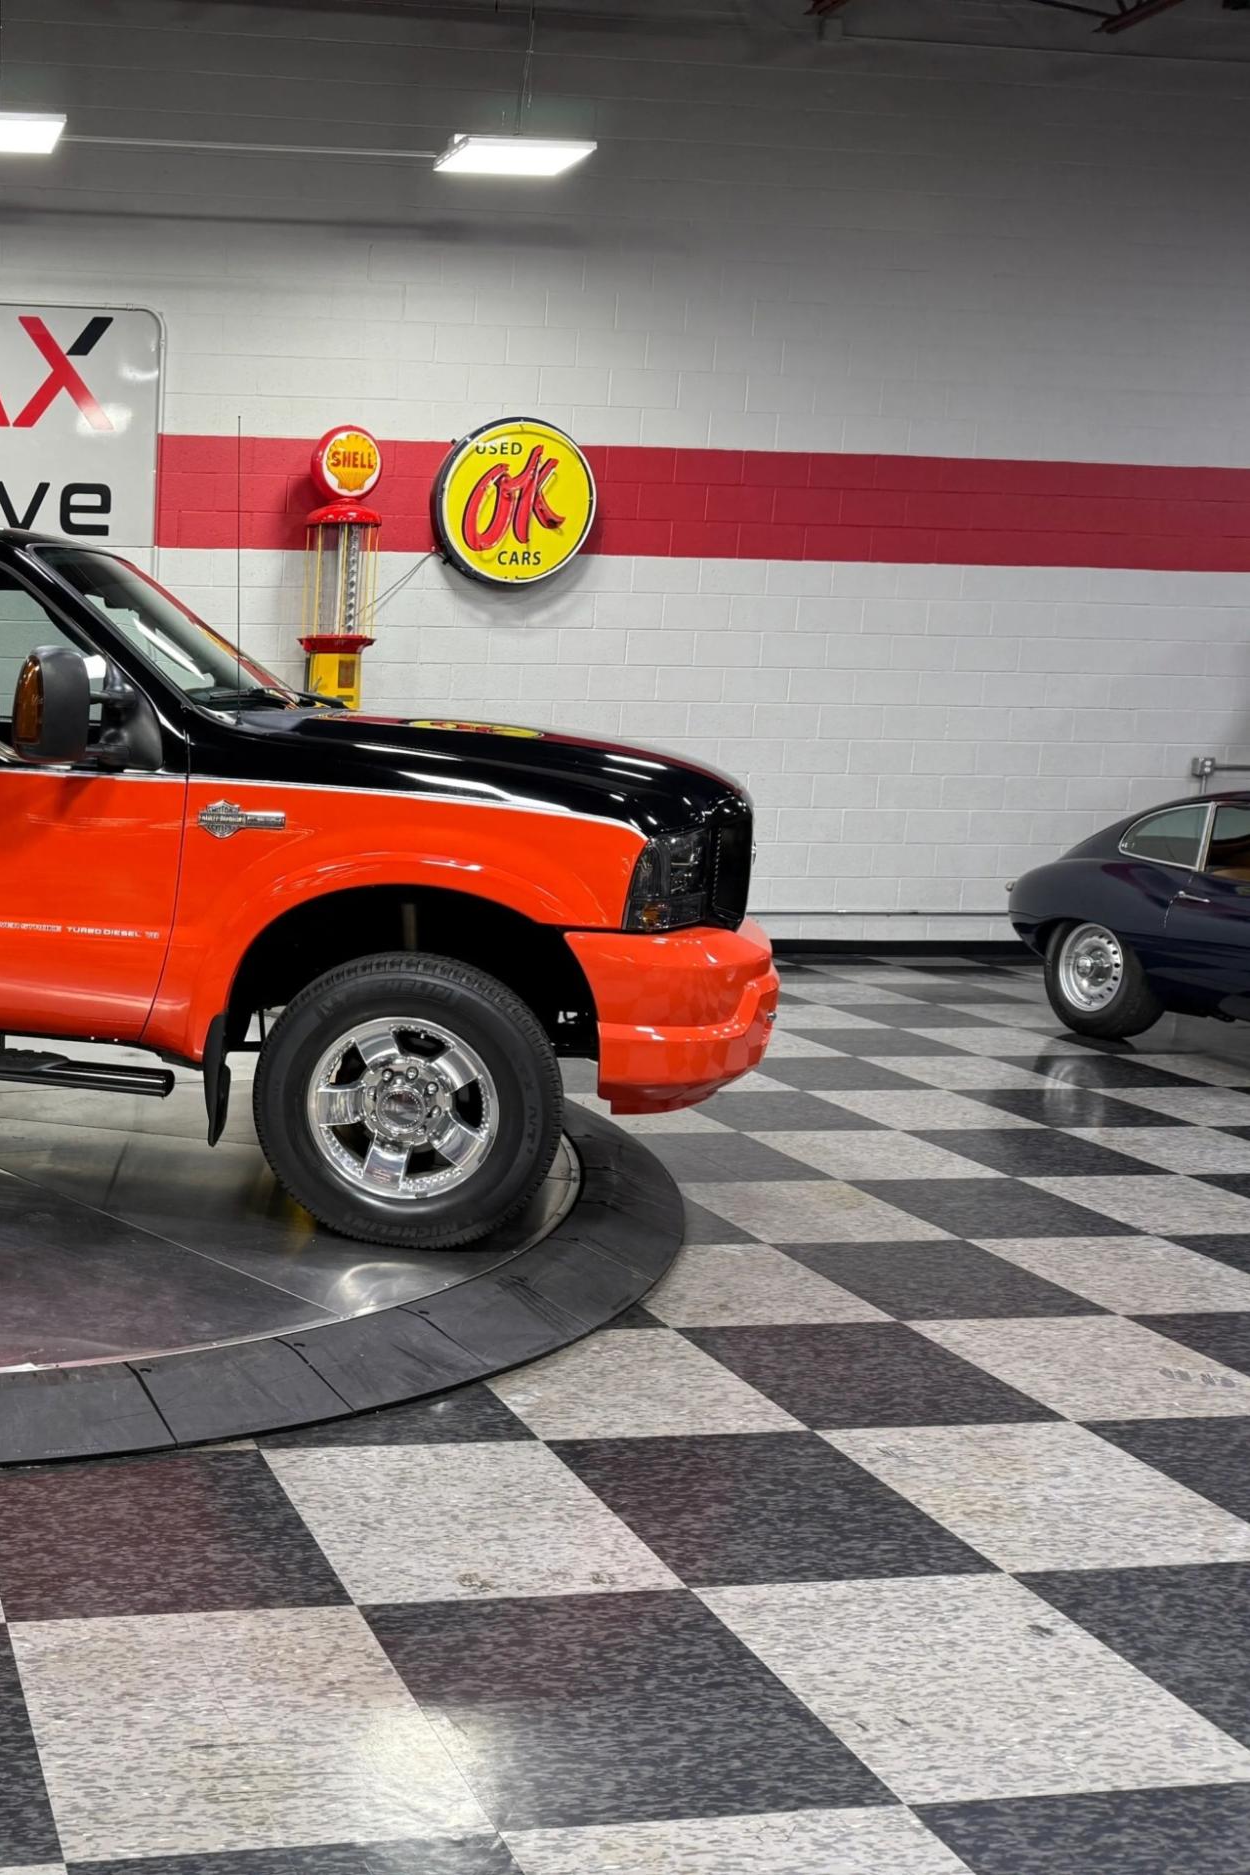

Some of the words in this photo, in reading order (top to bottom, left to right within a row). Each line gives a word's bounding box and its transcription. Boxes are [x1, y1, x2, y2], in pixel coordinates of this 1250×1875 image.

[475, 441, 523, 456] USED
[330, 450, 374, 470] SHELL
[461, 444, 566, 552] OK
[497, 551, 542, 567] CARS
